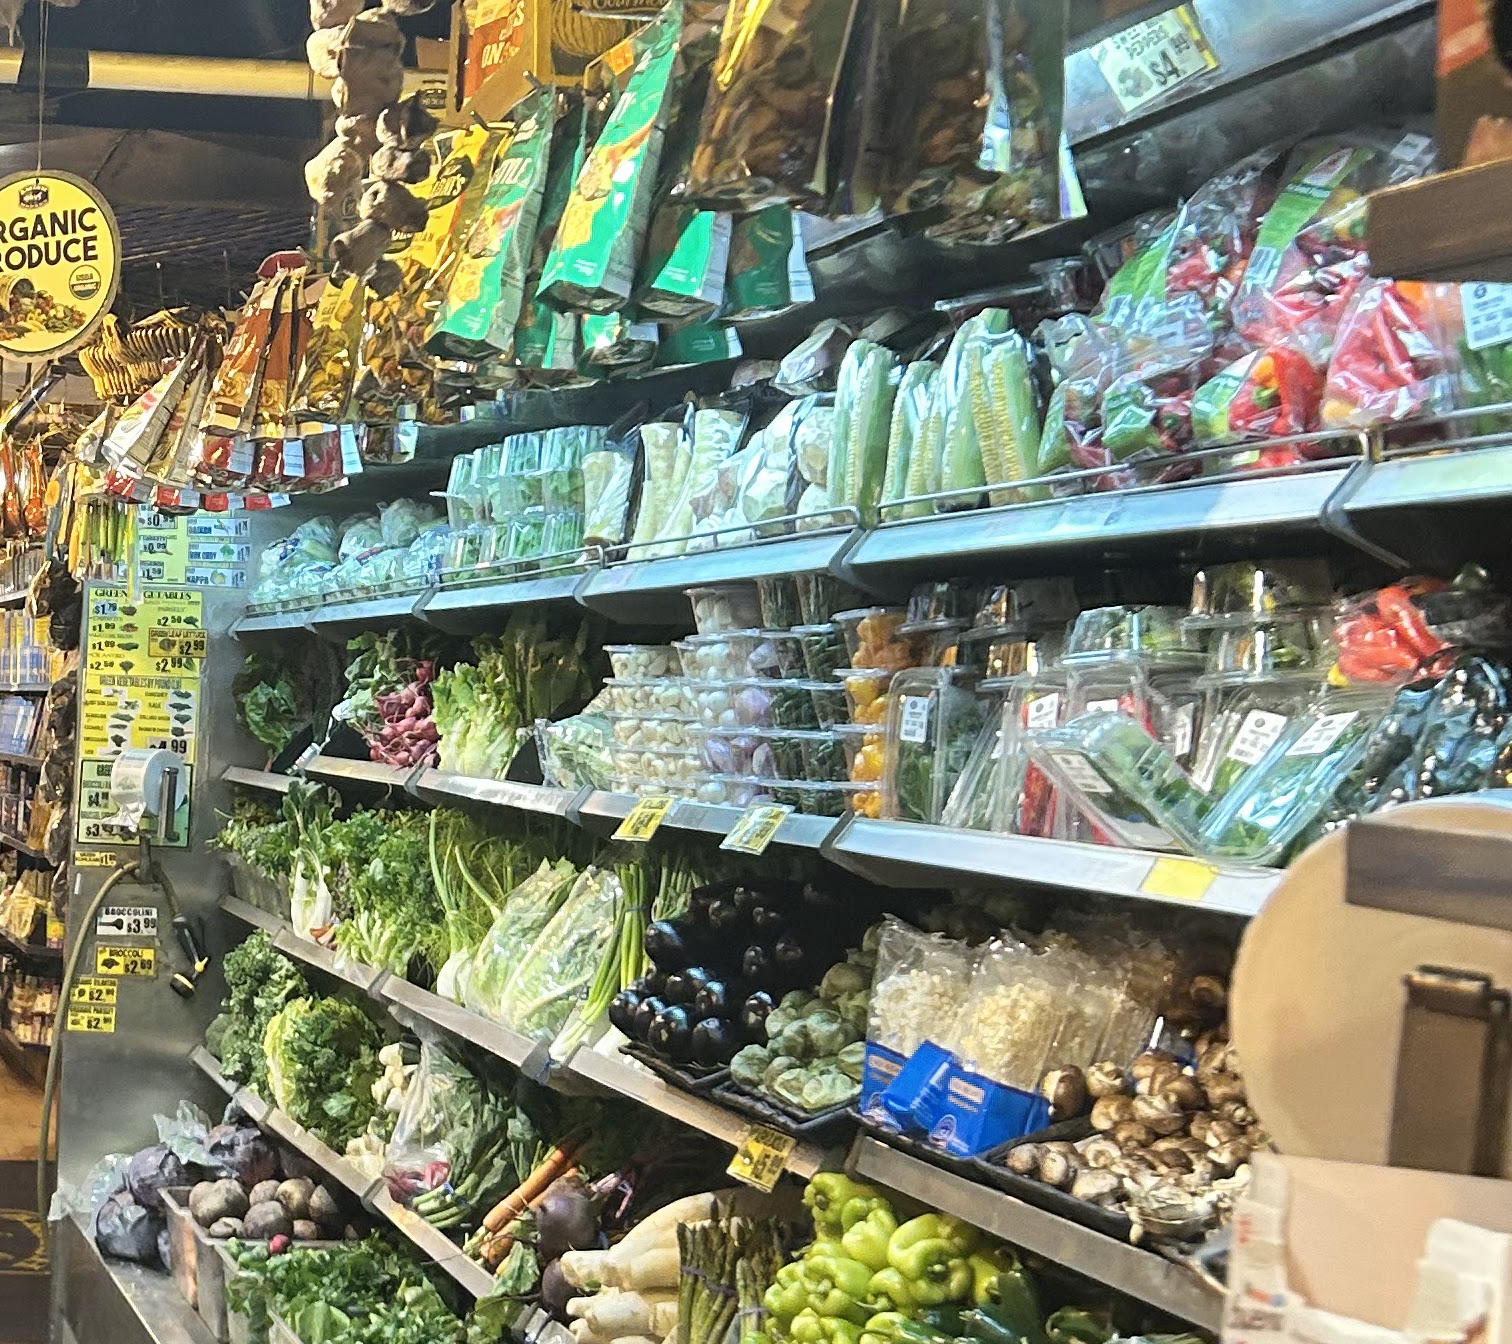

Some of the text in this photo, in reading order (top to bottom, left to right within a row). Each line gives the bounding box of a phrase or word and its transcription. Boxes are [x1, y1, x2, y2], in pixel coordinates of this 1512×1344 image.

[95, 589, 192, 599] GREEN GETABLES
[105, 908, 153, 916] BROCCOLINI
[109, 949, 143, 957] BROCCOLI
